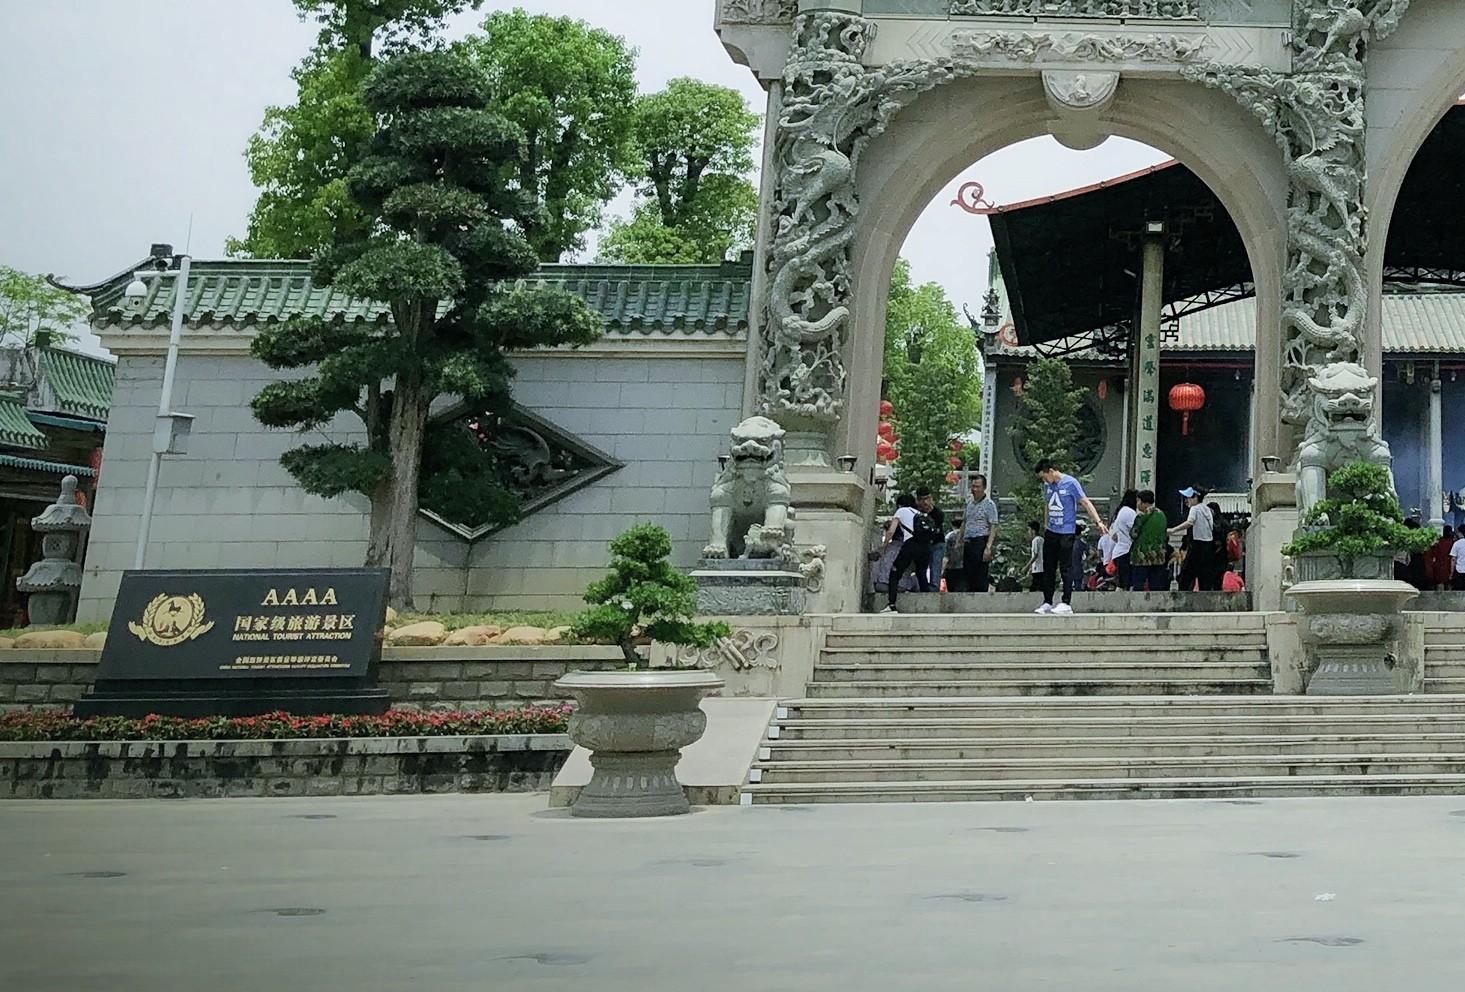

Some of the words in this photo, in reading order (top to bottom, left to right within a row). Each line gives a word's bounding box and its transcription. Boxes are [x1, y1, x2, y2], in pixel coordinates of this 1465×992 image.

[260, 588, 338, 606] AAAA
[234, 614, 356, 631] 国家级旅游景区
[232, 633, 270, 641] NATIONAL
[272, 632, 304, 641] TOURIST
[305, 632, 352, 640] ATTRACTION
